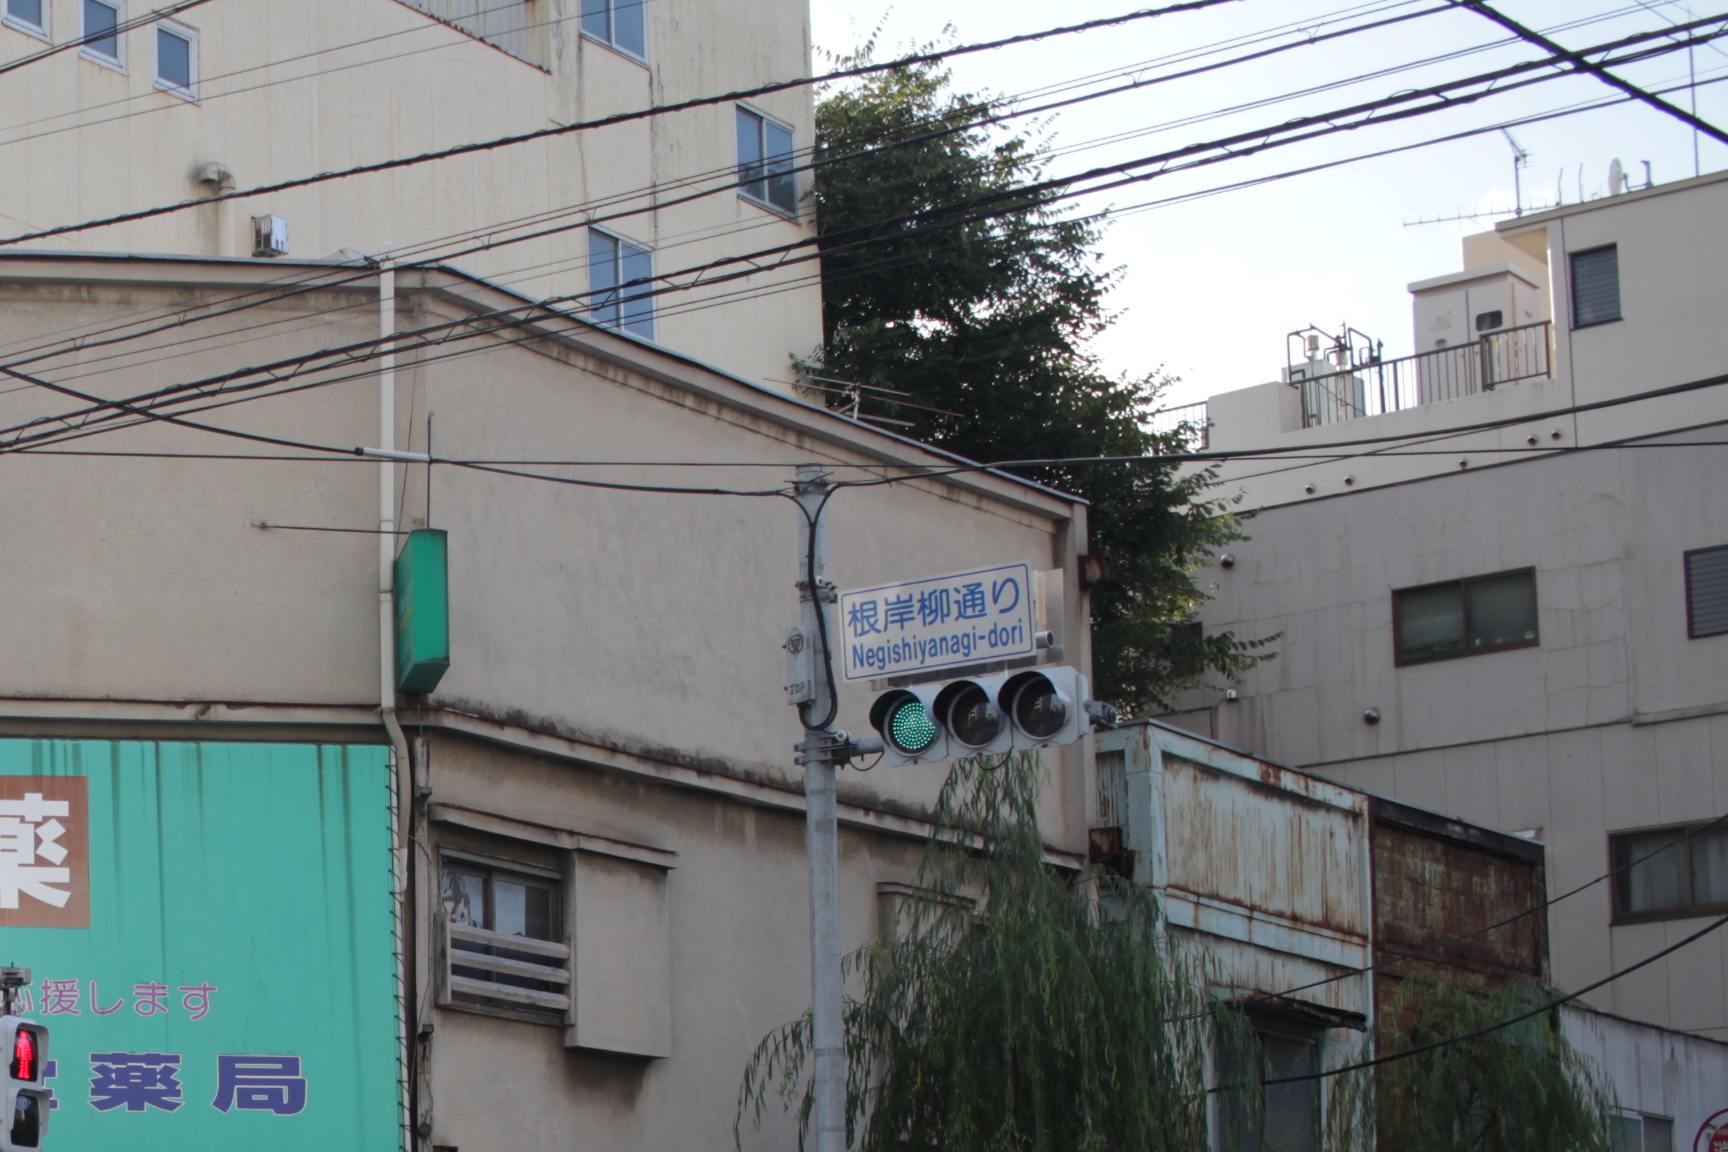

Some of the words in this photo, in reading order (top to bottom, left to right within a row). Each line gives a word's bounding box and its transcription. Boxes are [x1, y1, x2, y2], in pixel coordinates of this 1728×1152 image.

[848, 577, 1020, 638] 根岸柳通り
[852, 618, 1023, 671] Negishiyanagi-dori
